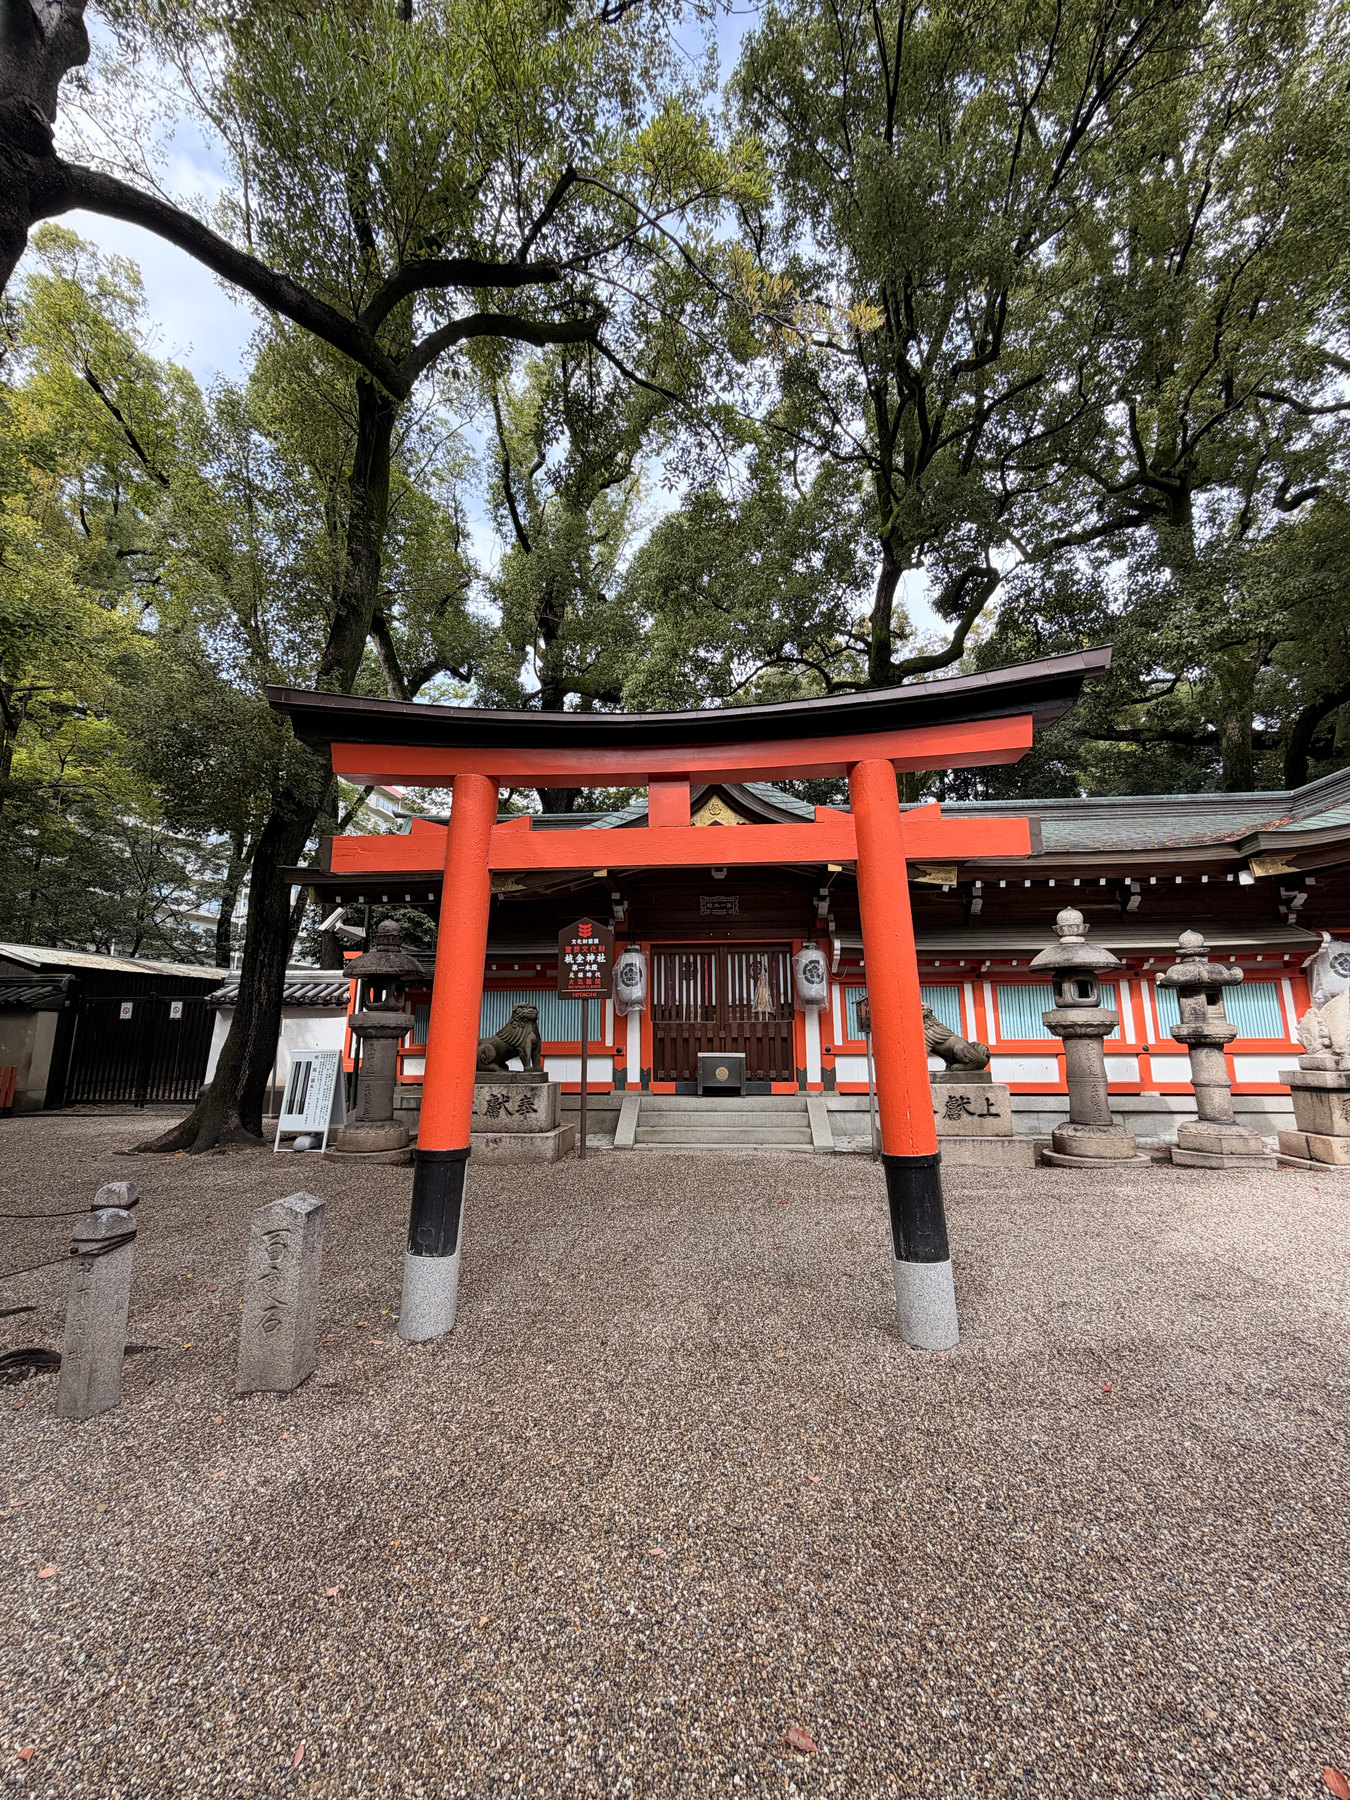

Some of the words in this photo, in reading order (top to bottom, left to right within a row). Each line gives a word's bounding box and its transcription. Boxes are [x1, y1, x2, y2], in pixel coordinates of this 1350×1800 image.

[565, 945, 605, 953] 重要文化財
[564, 953, 606, 963] 杭全神社
